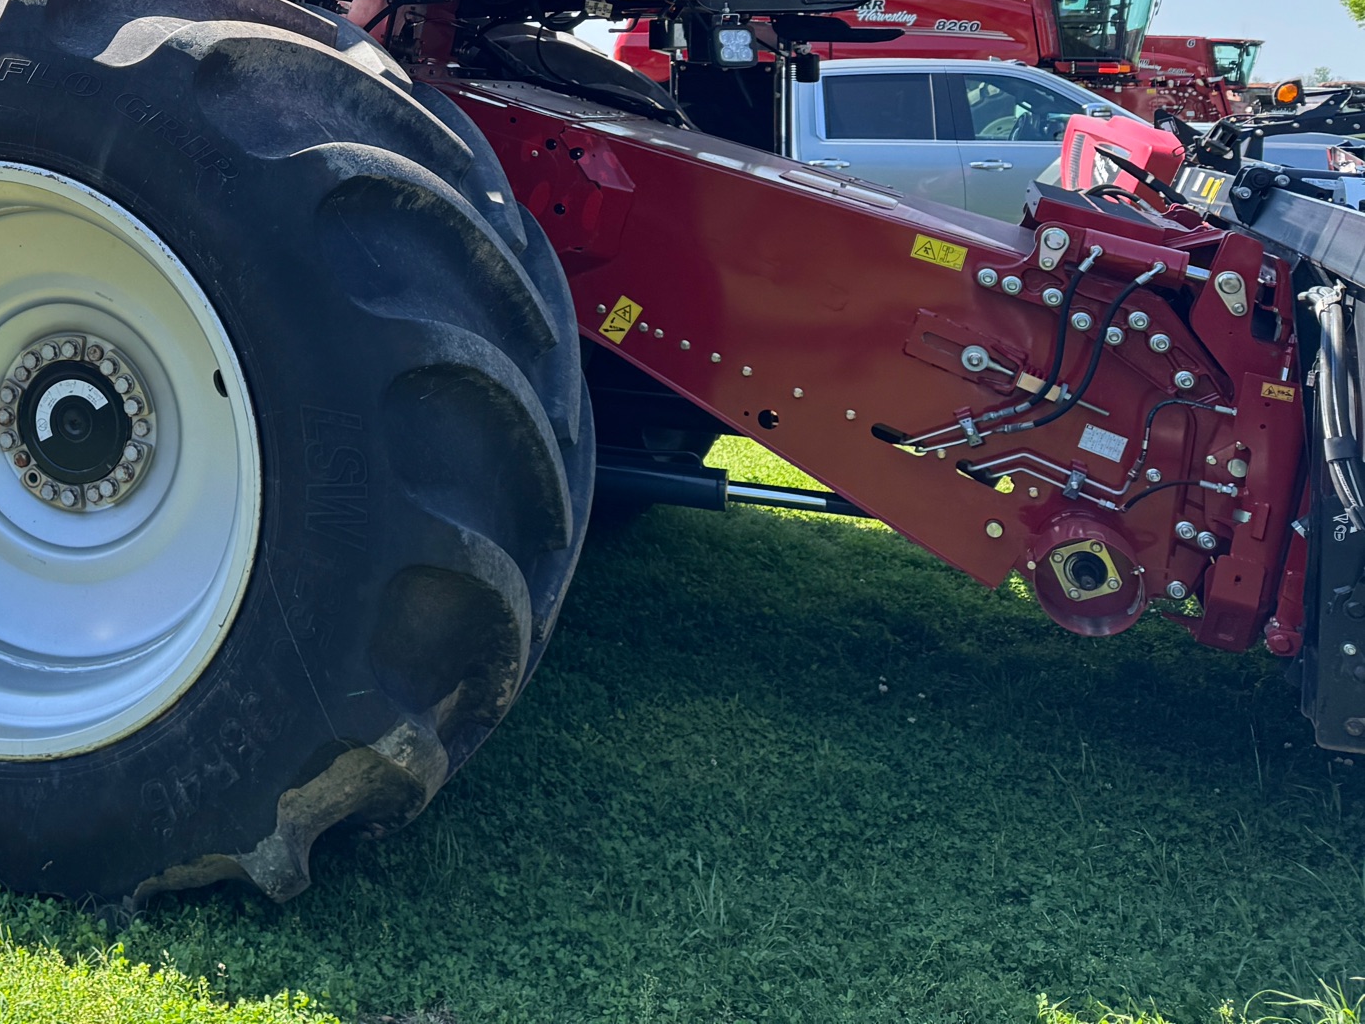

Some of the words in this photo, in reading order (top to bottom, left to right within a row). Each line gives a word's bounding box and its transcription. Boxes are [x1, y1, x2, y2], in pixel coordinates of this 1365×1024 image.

[856, 9, 917, 26] Harvesting
[935, 19, 981, 33] 8260
[1186, 38, 1196, 49] 6
[113, 92, 239, 182] GRIP
[299, 403, 369, 552] LSW
